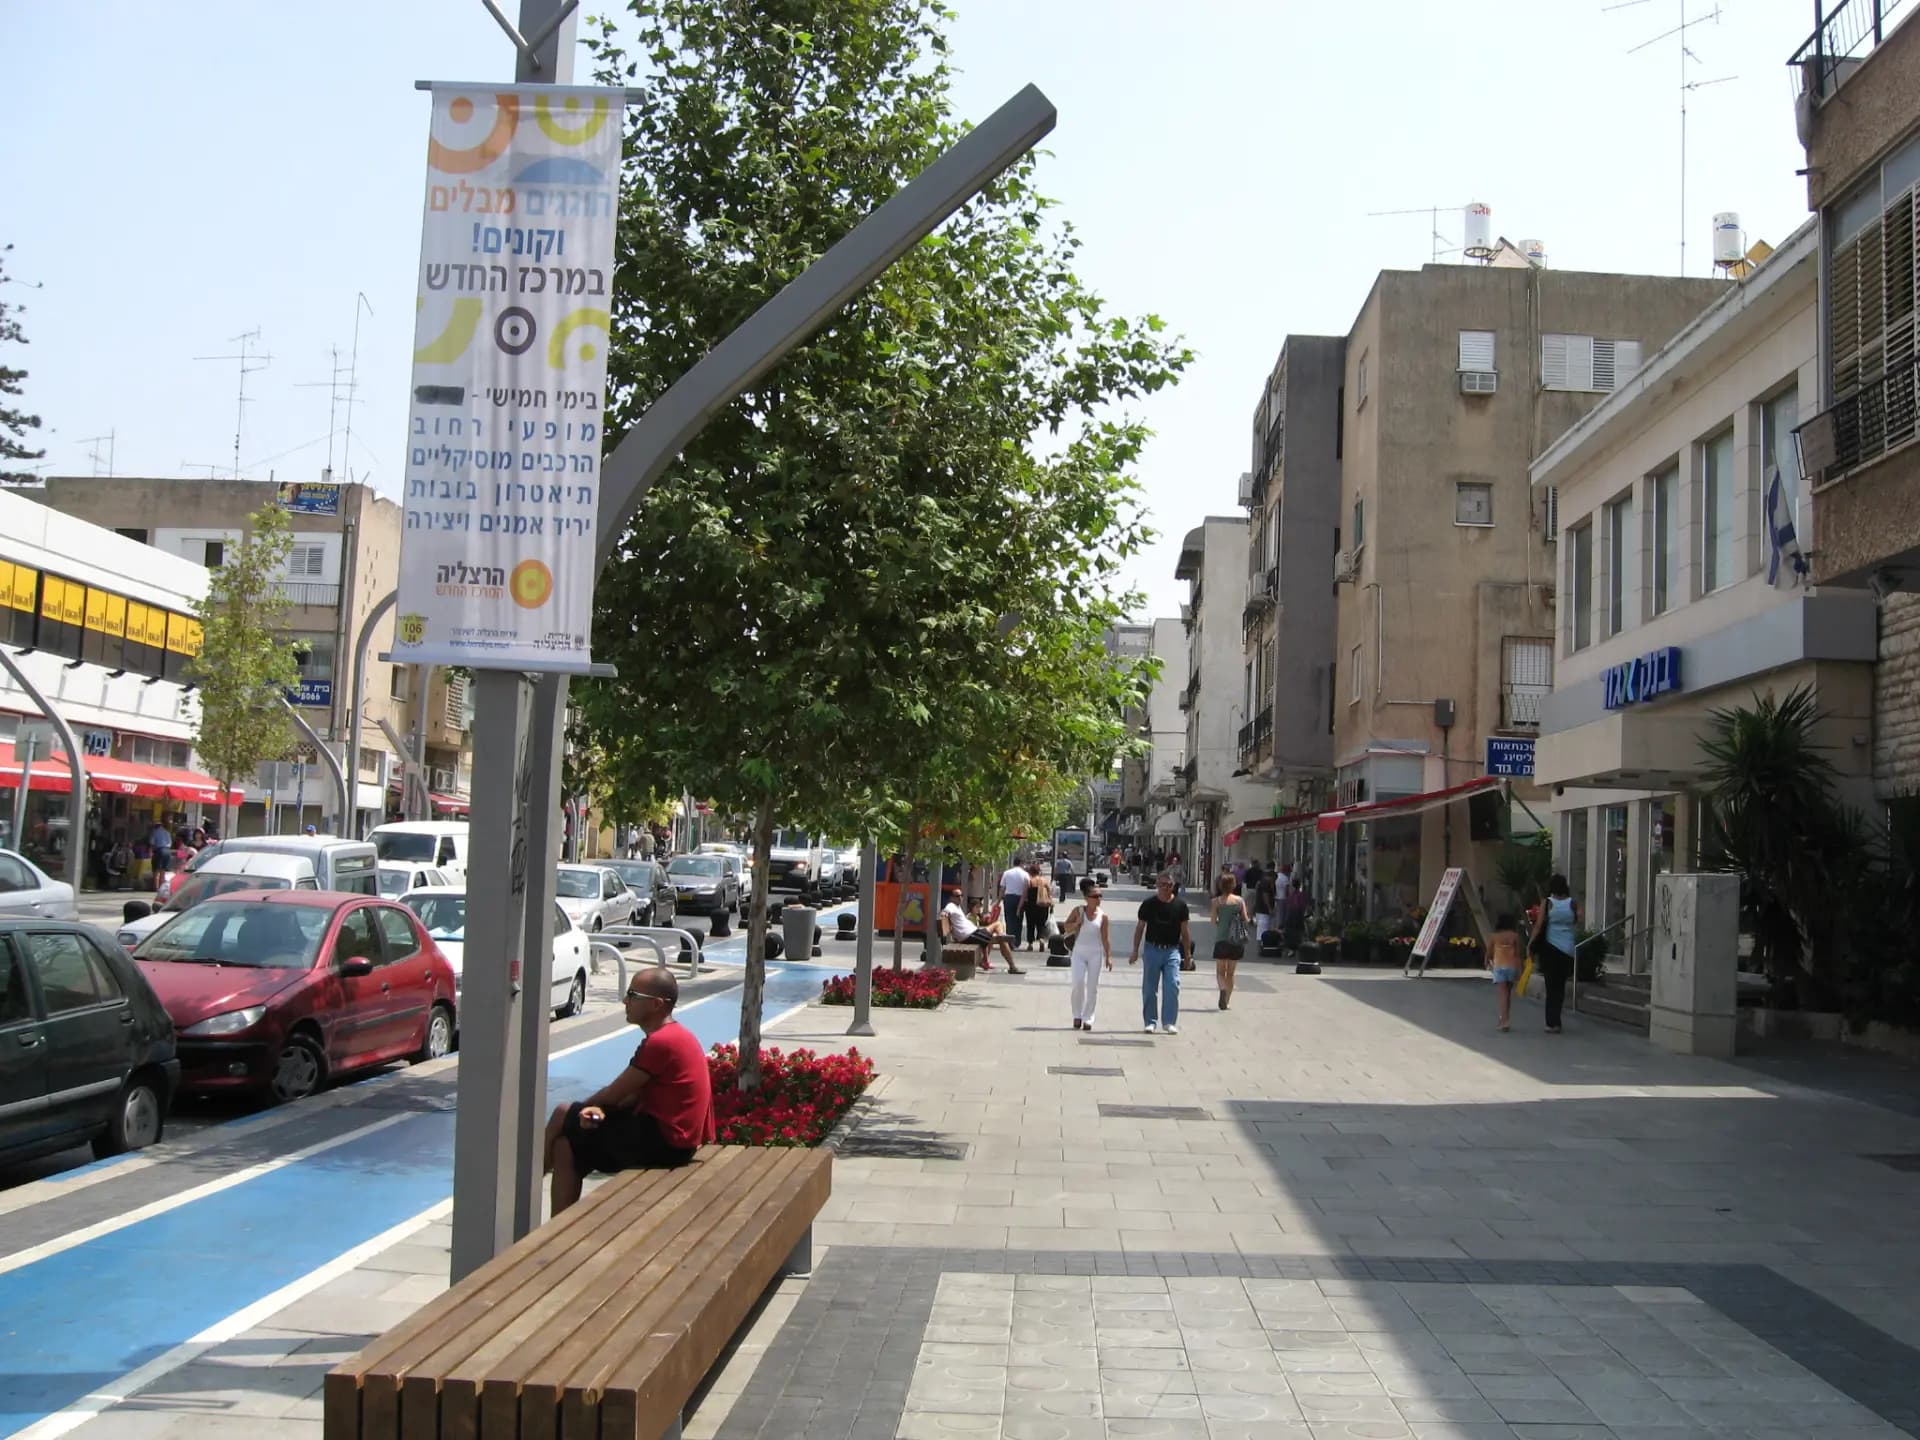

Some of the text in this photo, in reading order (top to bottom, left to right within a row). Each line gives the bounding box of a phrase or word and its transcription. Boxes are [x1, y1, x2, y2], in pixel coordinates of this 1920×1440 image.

[430, 179, 516, 214] מבלים
[472, 222, 565, 263] וקונים!
[426, 263, 605, 296] במרכז החדש
[486, 387, 547, 409] חמישי
[556, 390, 598, 410] בימי
[413, 416, 596, 442] מופעי רחוב
[412, 443, 594, 473] הרכבים מוסיקליים
[409, 479, 592, 507] תיאטרון בובות
[407, 510, 591, 537] יריד אמנים ויצירה
[437, 560, 505, 586] הרצליה
[404, 623, 422, 633] 106
[1640, 647, 1681, 702] בנק
